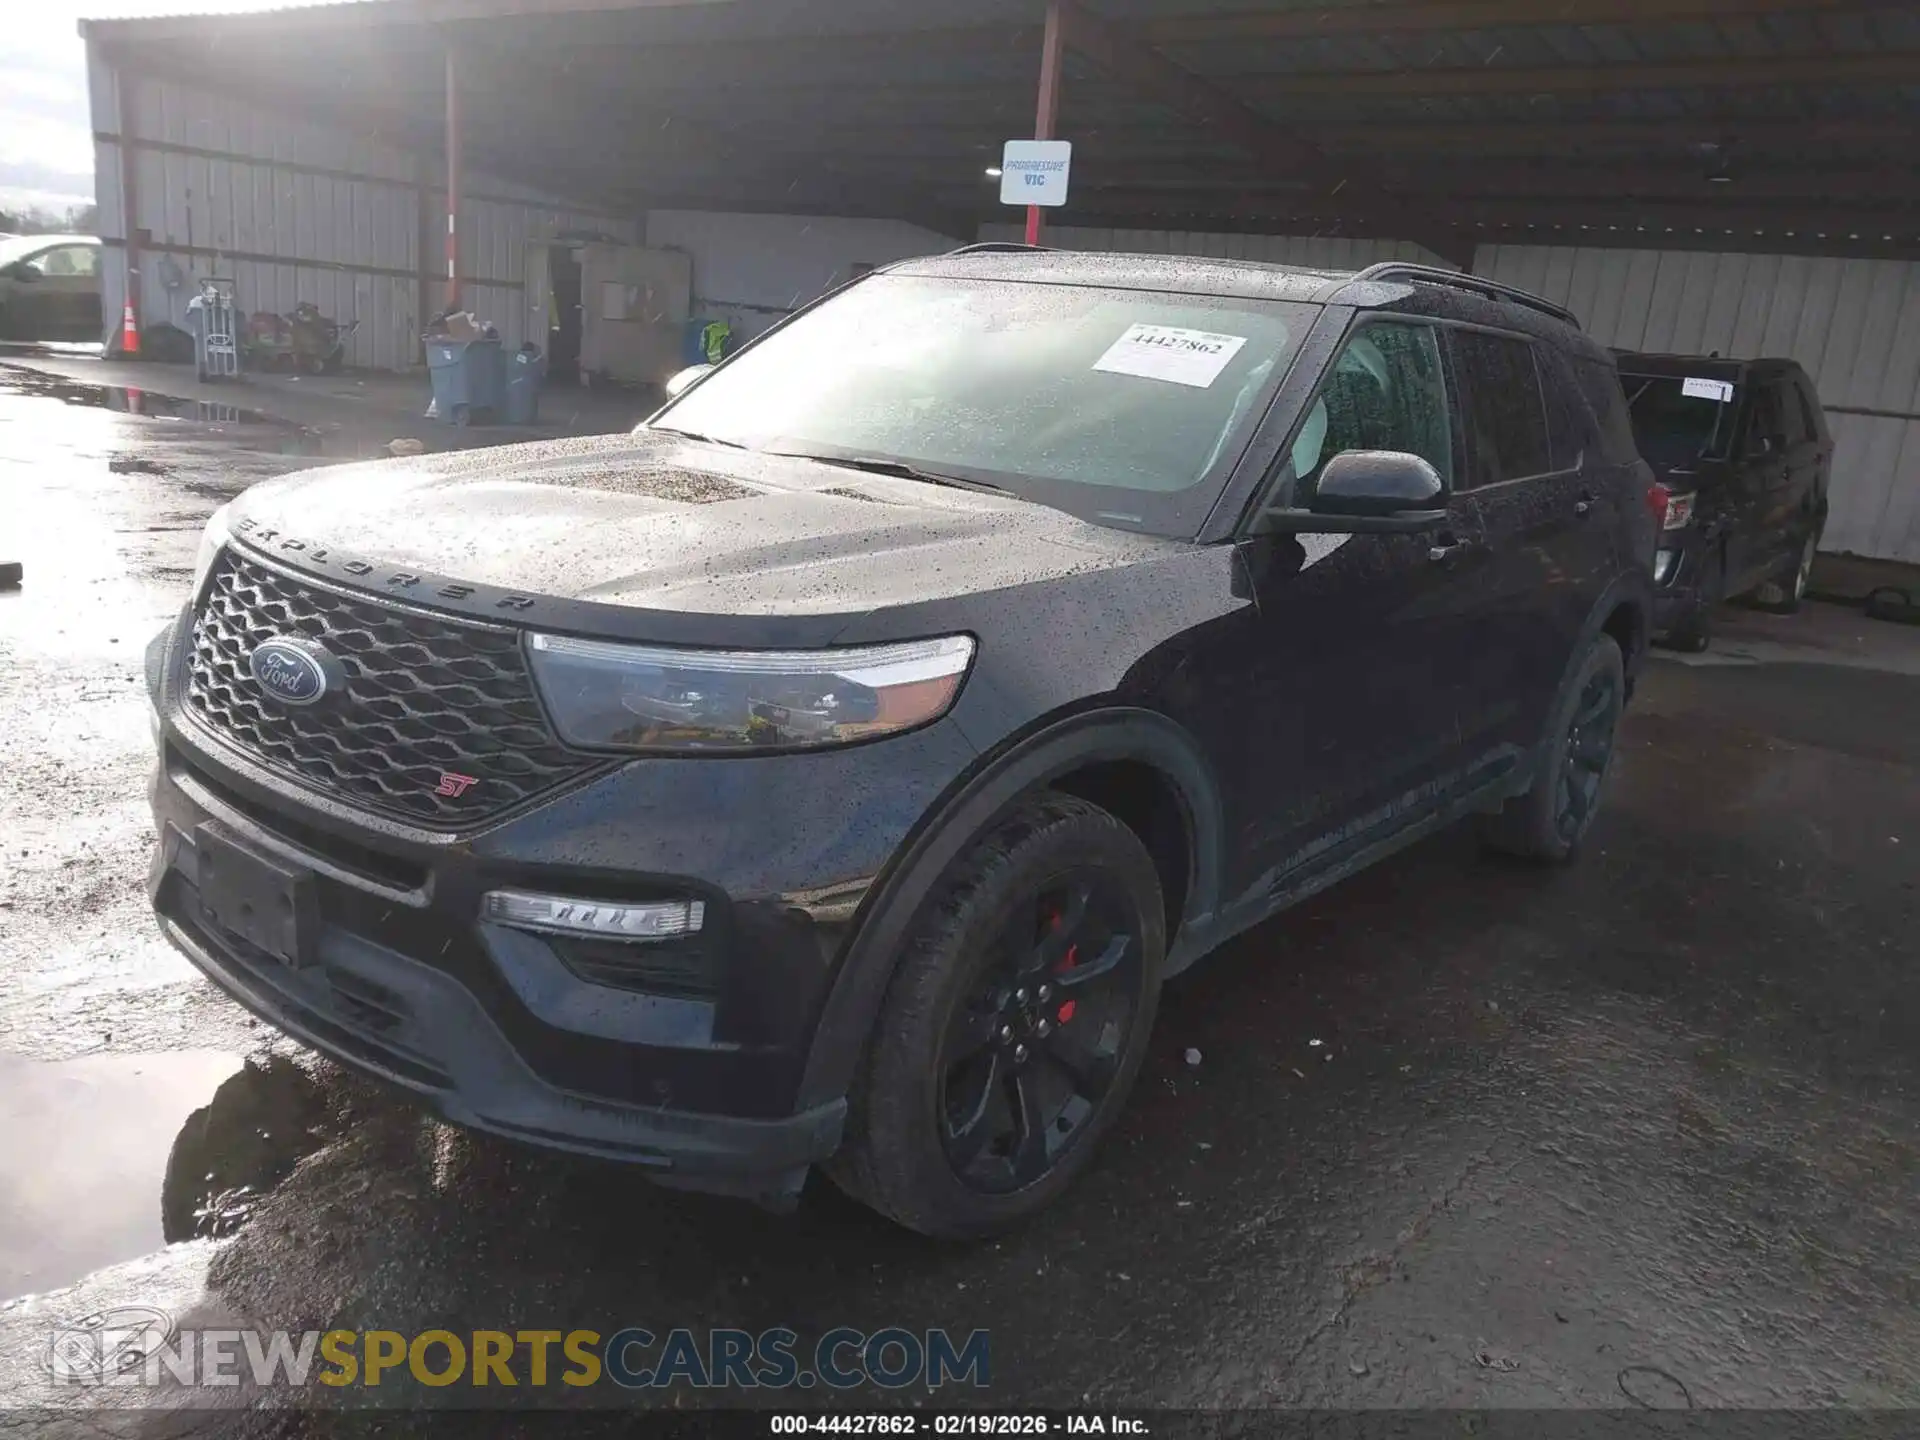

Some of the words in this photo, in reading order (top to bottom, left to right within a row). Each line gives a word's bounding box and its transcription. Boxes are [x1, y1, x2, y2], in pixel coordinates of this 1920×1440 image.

[1025, 174, 1046, 186] VIC
[1132, 334, 1223, 355] 44427862
[236, 518, 536, 610] EXPLORER
[261, 652, 304, 693] Ford
[434, 772, 480, 797] ST
